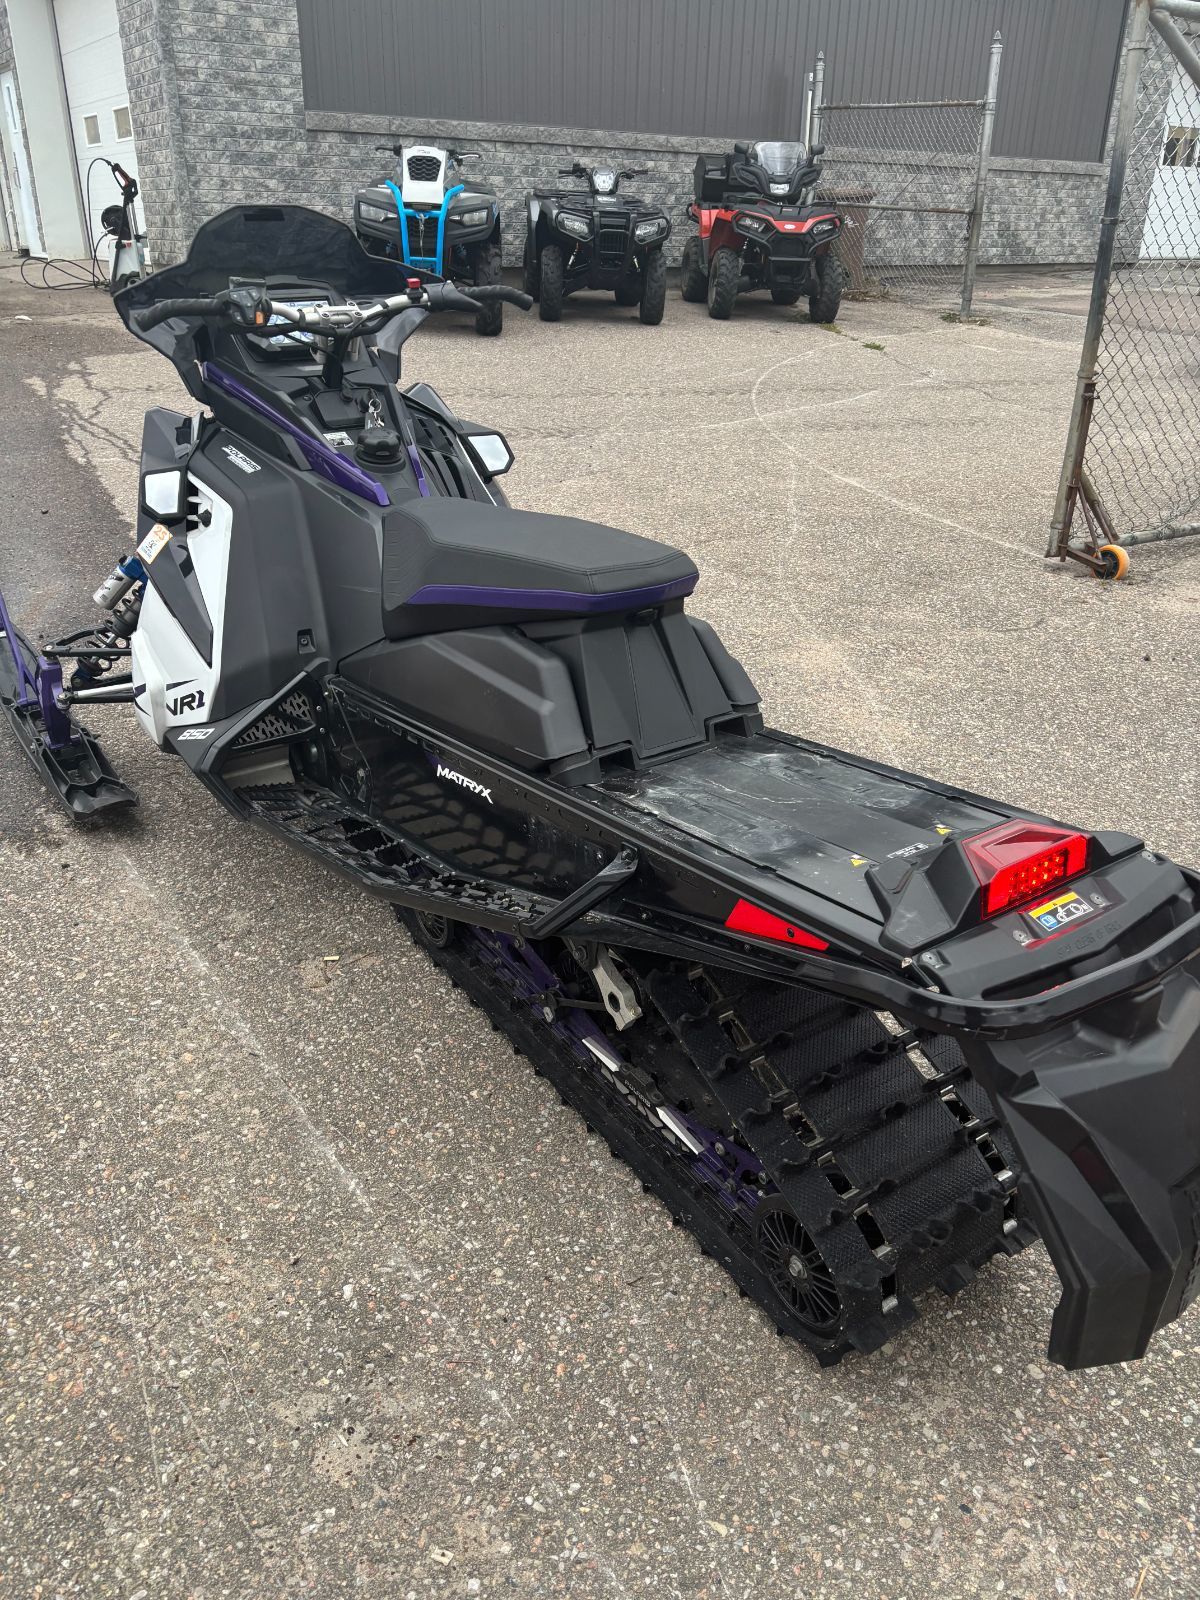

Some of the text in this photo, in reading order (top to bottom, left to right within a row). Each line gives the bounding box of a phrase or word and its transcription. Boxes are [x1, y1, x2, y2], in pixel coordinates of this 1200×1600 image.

[153, 526, 168, 541] 25
[177, 728, 216, 741] 850
[436, 763, 494, 805] MATRYX
